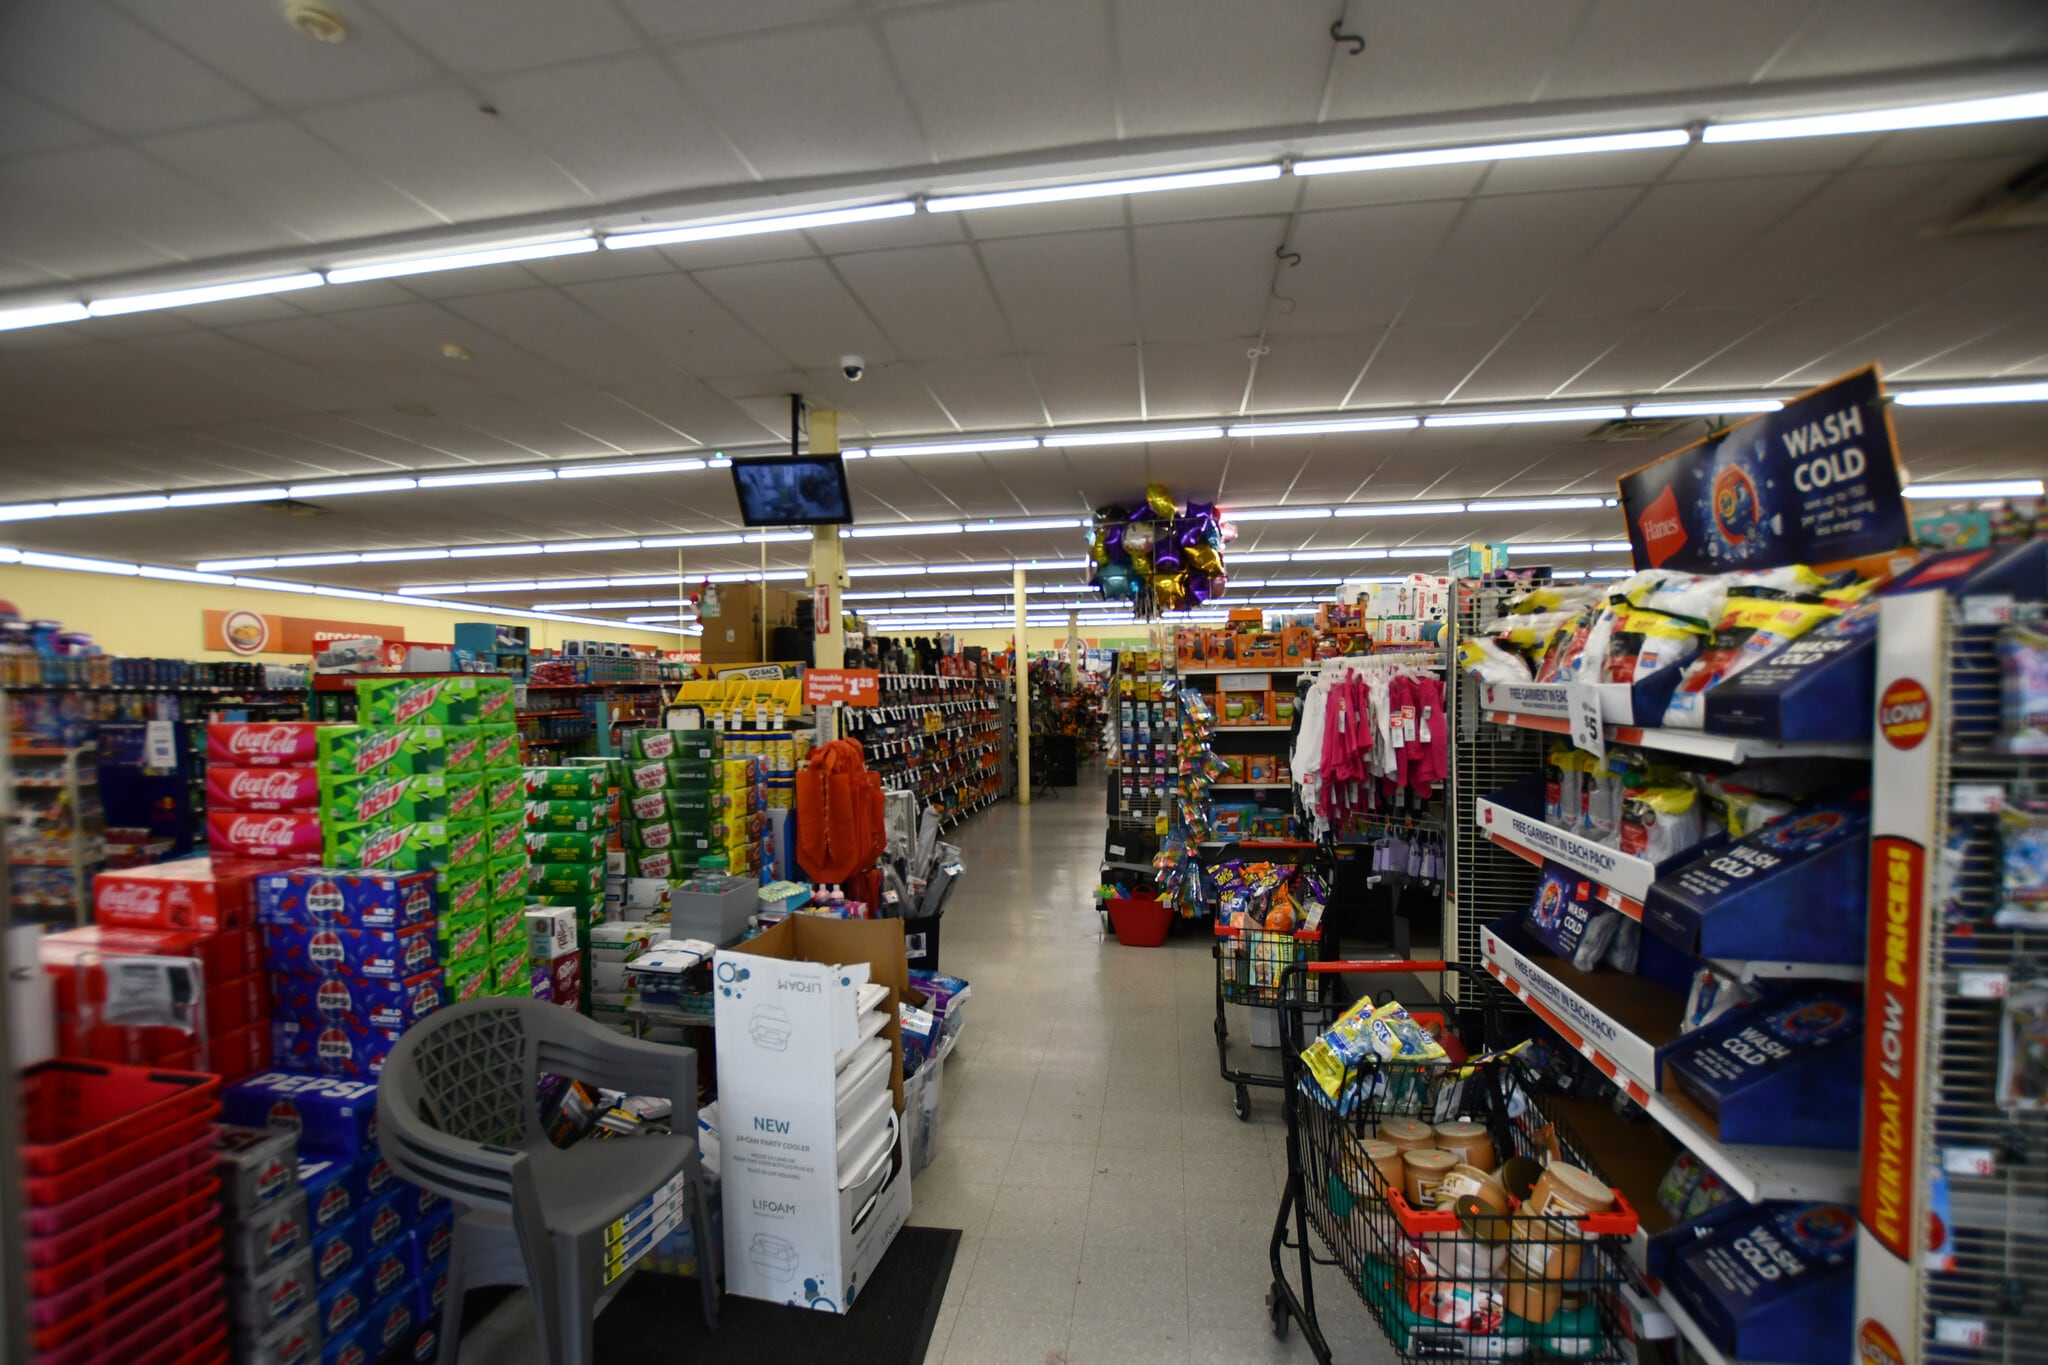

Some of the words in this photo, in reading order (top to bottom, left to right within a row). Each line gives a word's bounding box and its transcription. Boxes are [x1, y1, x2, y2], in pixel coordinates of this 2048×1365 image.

[1782, 405, 1864, 458] WASH
[1794, 448, 1867, 492] COLD
[1645, 517, 1679, 541] Hanes
[669, 653, 701, 663] SAVING
[809, 674, 843, 682] Reusable
[809, 683, 844, 693] Shopping
[1883, 701, 1926, 725] LOW
[229, 726, 301, 754] Coca-Cola
[642, 737, 674, 751] CANADA
[651, 747, 667, 757] DRY
[633, 767, 667, 780] CANADA
[643, 777, 661, 788] DRY
[229, 771, 301, 799] Coca-Cola
[633, 797, 665, 810] CANADA
[642, 807, 660, 818] DRY
[228, 816, 298, 845] Coca-Cola
[641, 827, 672, 839] CANADA
[1512, 819, 1527, 834] FREE
[1527, 825, 1559, 848] GARMENT
[1560, 838, 1568, 850] IN
[1569, 842, 1590, 860] EACH
[650, 836, 666, 847] DRY
[639, 858, 672, 870] CANADA
[1728, 845, 1782, 869] WASH
[649, 867, 665, 878] DRY
[1710, 857, 1755, 878] COLD
[310, 895, 343, 907] PEPSI
[1567, 901, 1589, 922] WASH
[1885, 848, 1911, 986] PRICES!
[1563, 916, 1582, 934] COLD
[312, 946, 342, 957] PEPSI
[778, 979, 822, 993] LIFOAM
[1514, 957, 1529, 977] FREE
[1528, 969, 1561, 1000] GARMENT
[1561, 992, 1570, 1008] IN
[1569, 999, 1591, 1022] EACH
[319, 995, 349, 1007] PEPSI
[1739, 1027, 1791, 1059] WASH
[1880, 991, 1905, 1080] LOW
[320, 1042, 350, 1054] PEPSI
[1722, 1038, 1767, 1065] COLD
[243, 1072, 379, 1099] PEPSI
[754, 1116, 790, 1134] NEW
[736, 1134, 760, 1145] 24-CAN
[761, 1138, 781, 1147] PARTY
[782, 1142, 810, 1152] COOLER
[1875, 1081, 1902, 1244] EVERYDAY
[752, 1199, 796, 1215] LIFOAM
[1734, 1238, 1780, 1280] COLD
